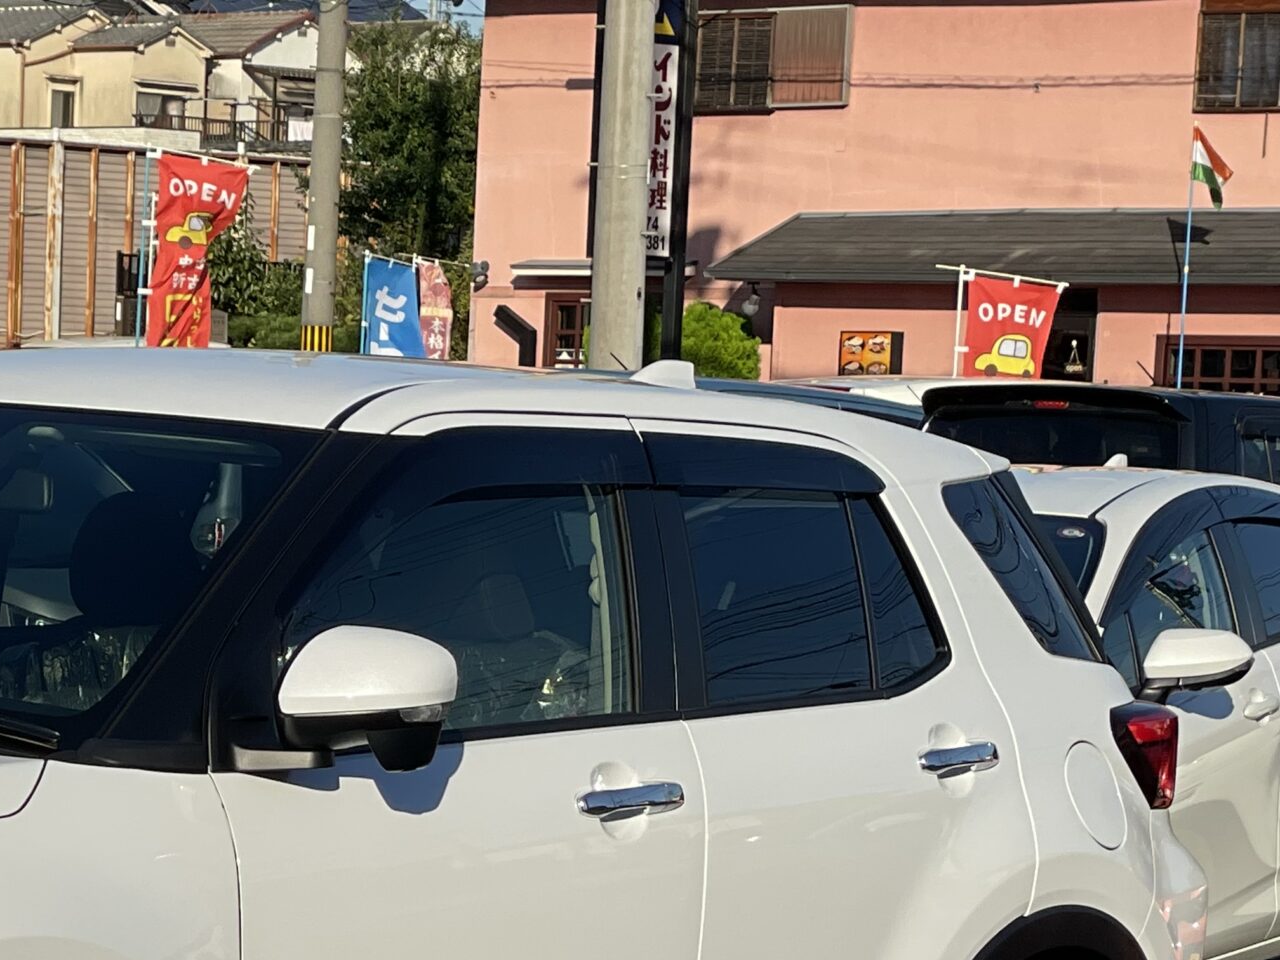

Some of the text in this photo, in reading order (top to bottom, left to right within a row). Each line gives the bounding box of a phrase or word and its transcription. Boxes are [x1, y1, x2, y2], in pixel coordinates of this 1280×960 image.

[649, 53, 672, 211] インド料理
[169, 177, 236, 209] OPEN
[978, 302, 1047, 329] OPEN
